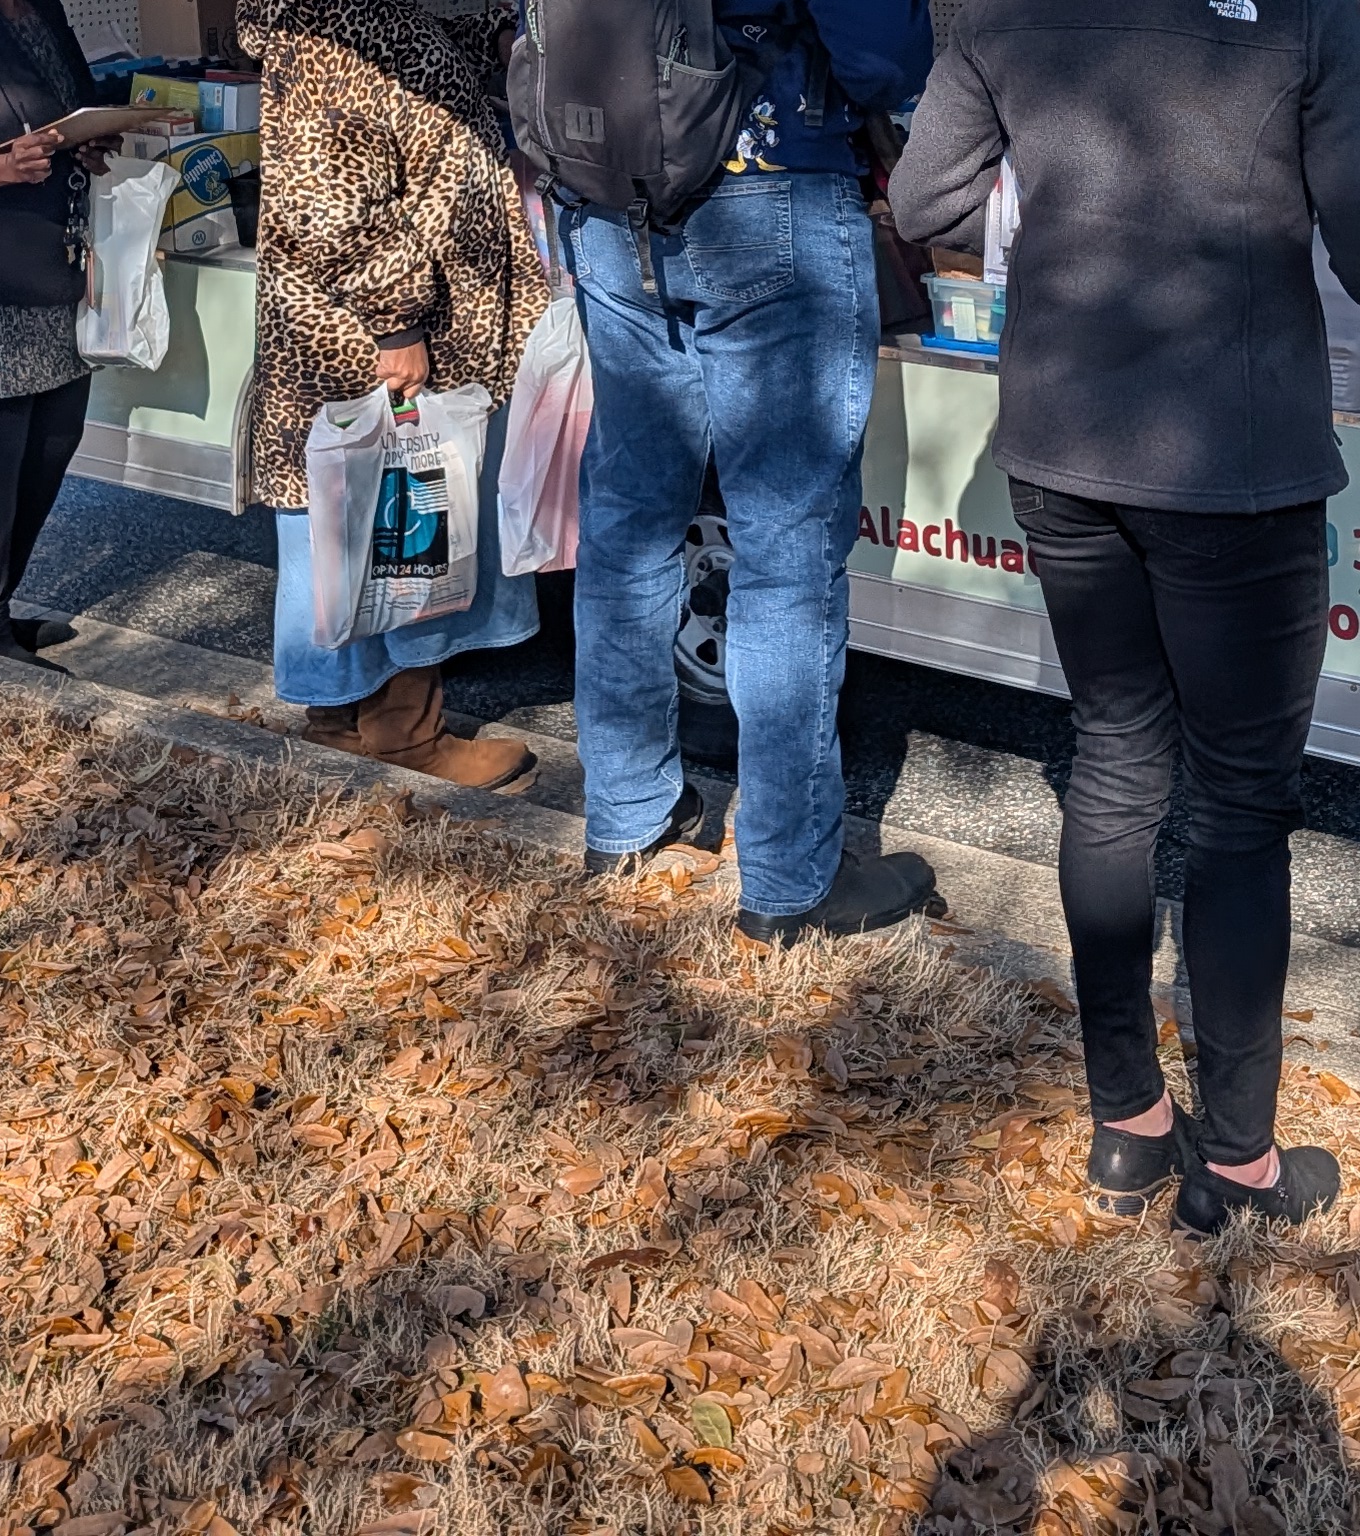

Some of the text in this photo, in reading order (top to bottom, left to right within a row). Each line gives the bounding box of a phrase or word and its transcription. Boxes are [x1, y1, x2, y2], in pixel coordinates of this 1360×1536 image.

[1208, 0, 1242, 12] NORTH
[1217, 8, 1241, 19] FACE
[381, 431, 440, 454] UNIERSITY
[384, 451, 441, 471] OPY MORE
[372, 565, 398, 576] OPN
[399, 564, 412, 576] 24
